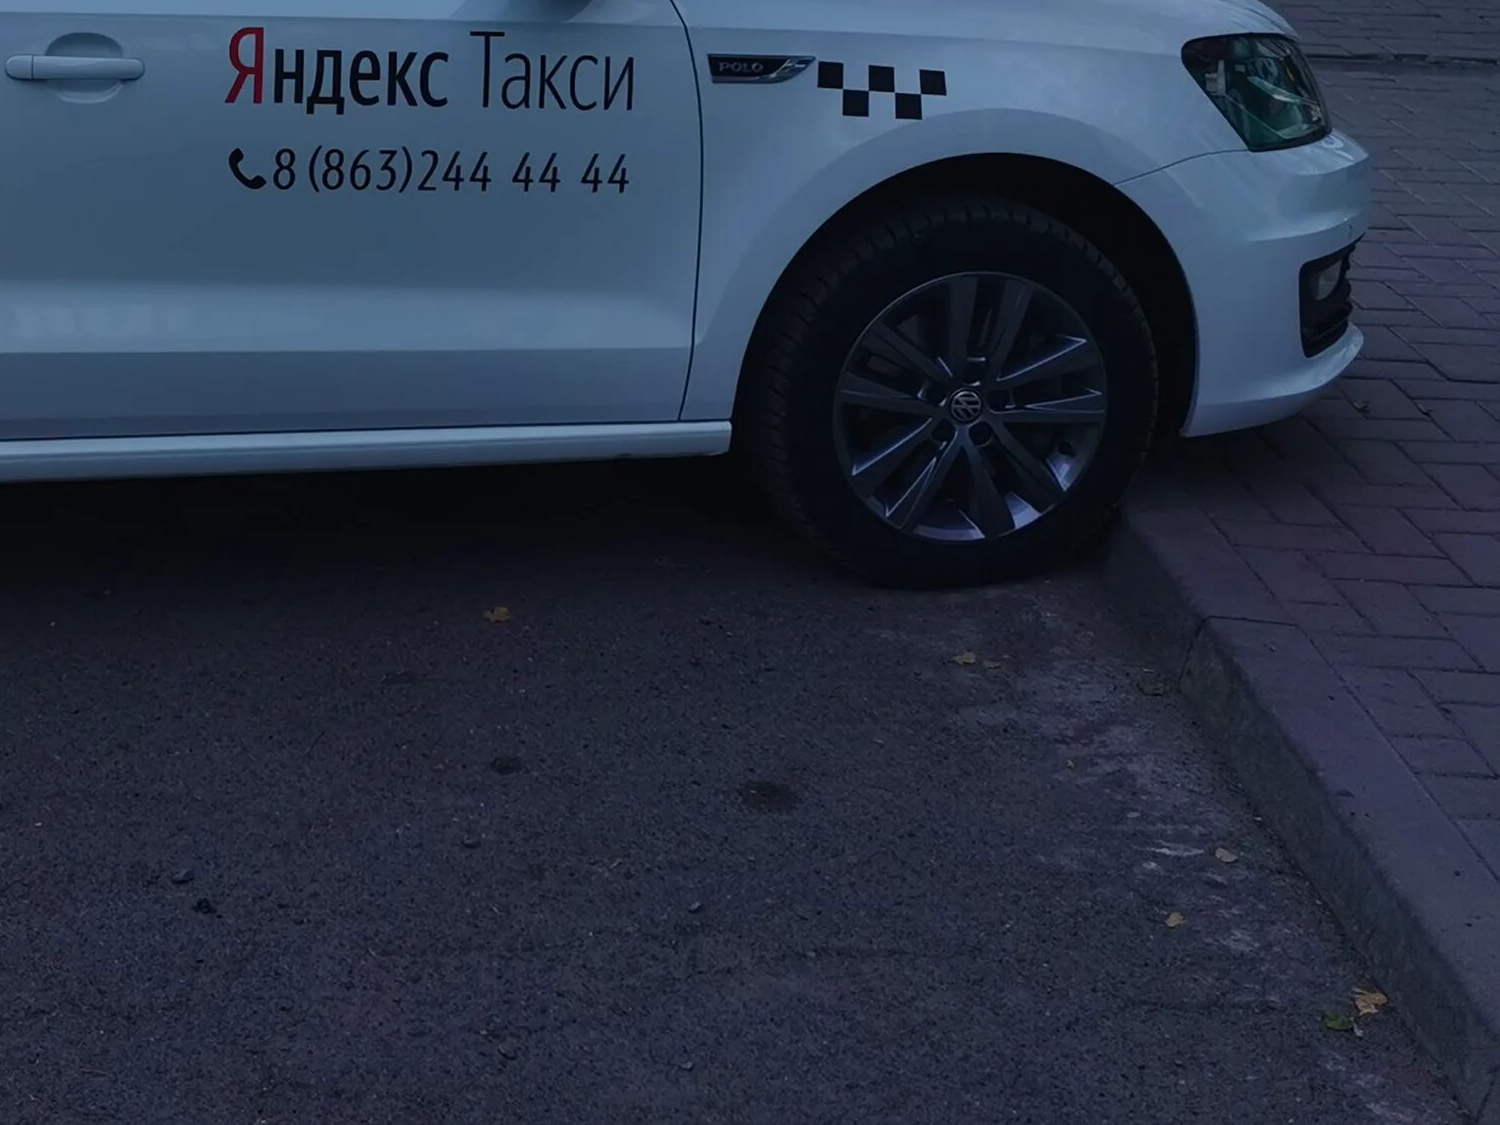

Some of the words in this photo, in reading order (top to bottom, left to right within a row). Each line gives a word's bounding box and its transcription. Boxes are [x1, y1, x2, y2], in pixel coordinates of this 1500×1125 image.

[224, 26, 449, 115] Яндекс
[469, 30, 635, 112] Такси
[719, 61, 764, 73] POLO
[511, 152, 562, 194] 44
[580, 153, 631, 195] 44
